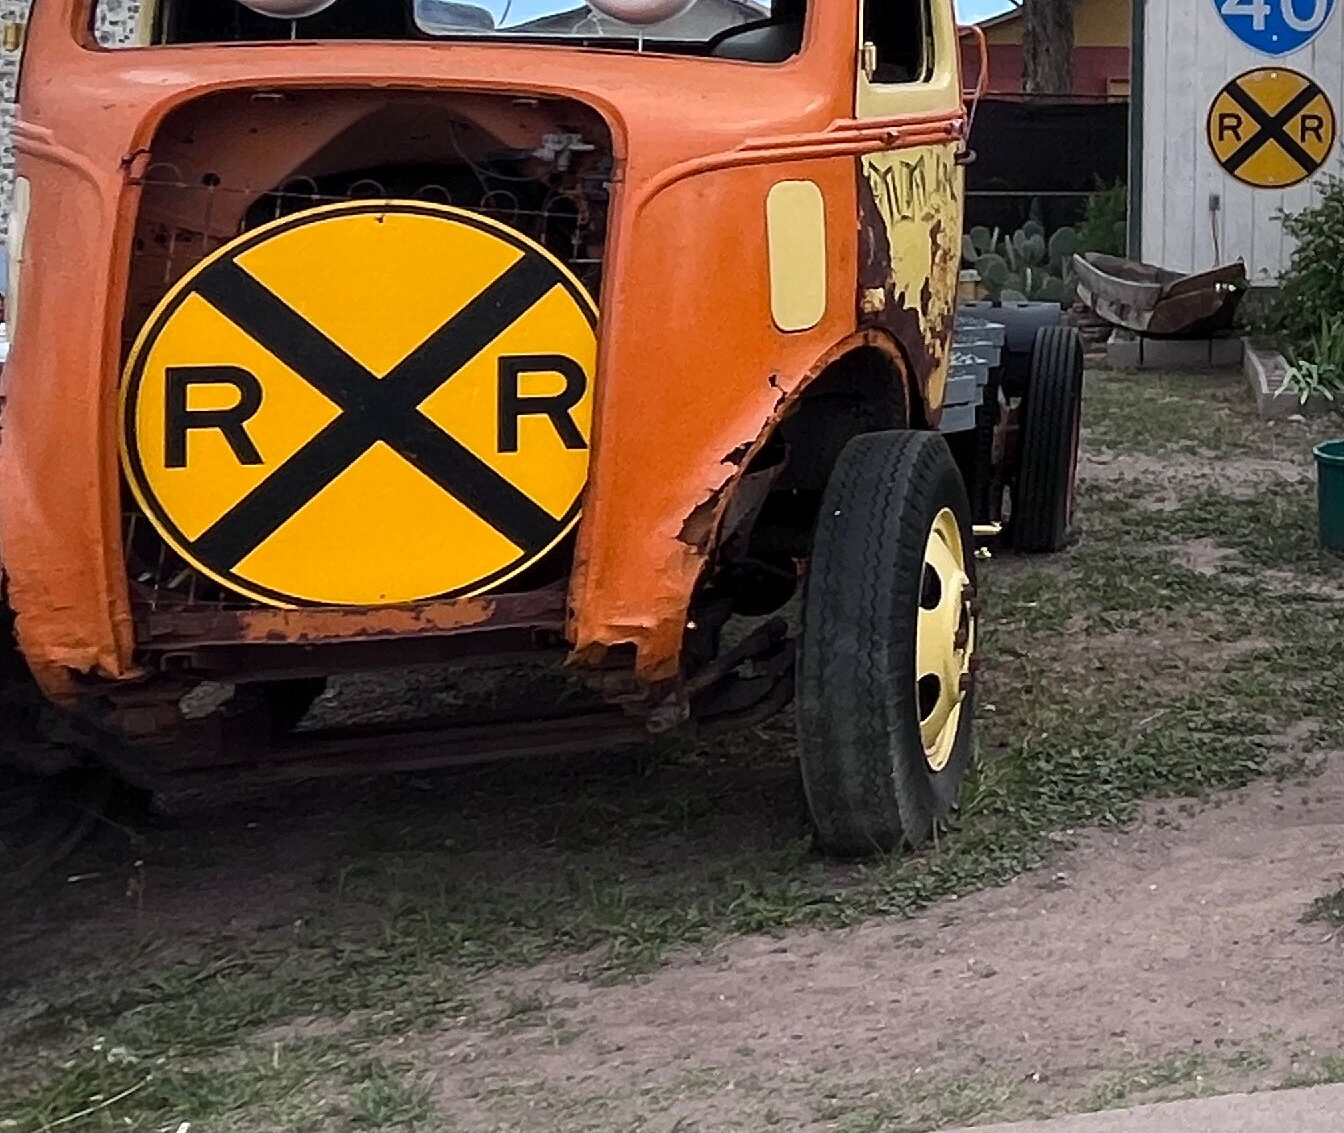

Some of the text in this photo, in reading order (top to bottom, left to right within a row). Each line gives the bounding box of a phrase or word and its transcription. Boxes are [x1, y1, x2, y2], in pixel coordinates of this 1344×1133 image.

[1218, 113, 1324, 143] R R
[162, 354, 589, 468] R R
